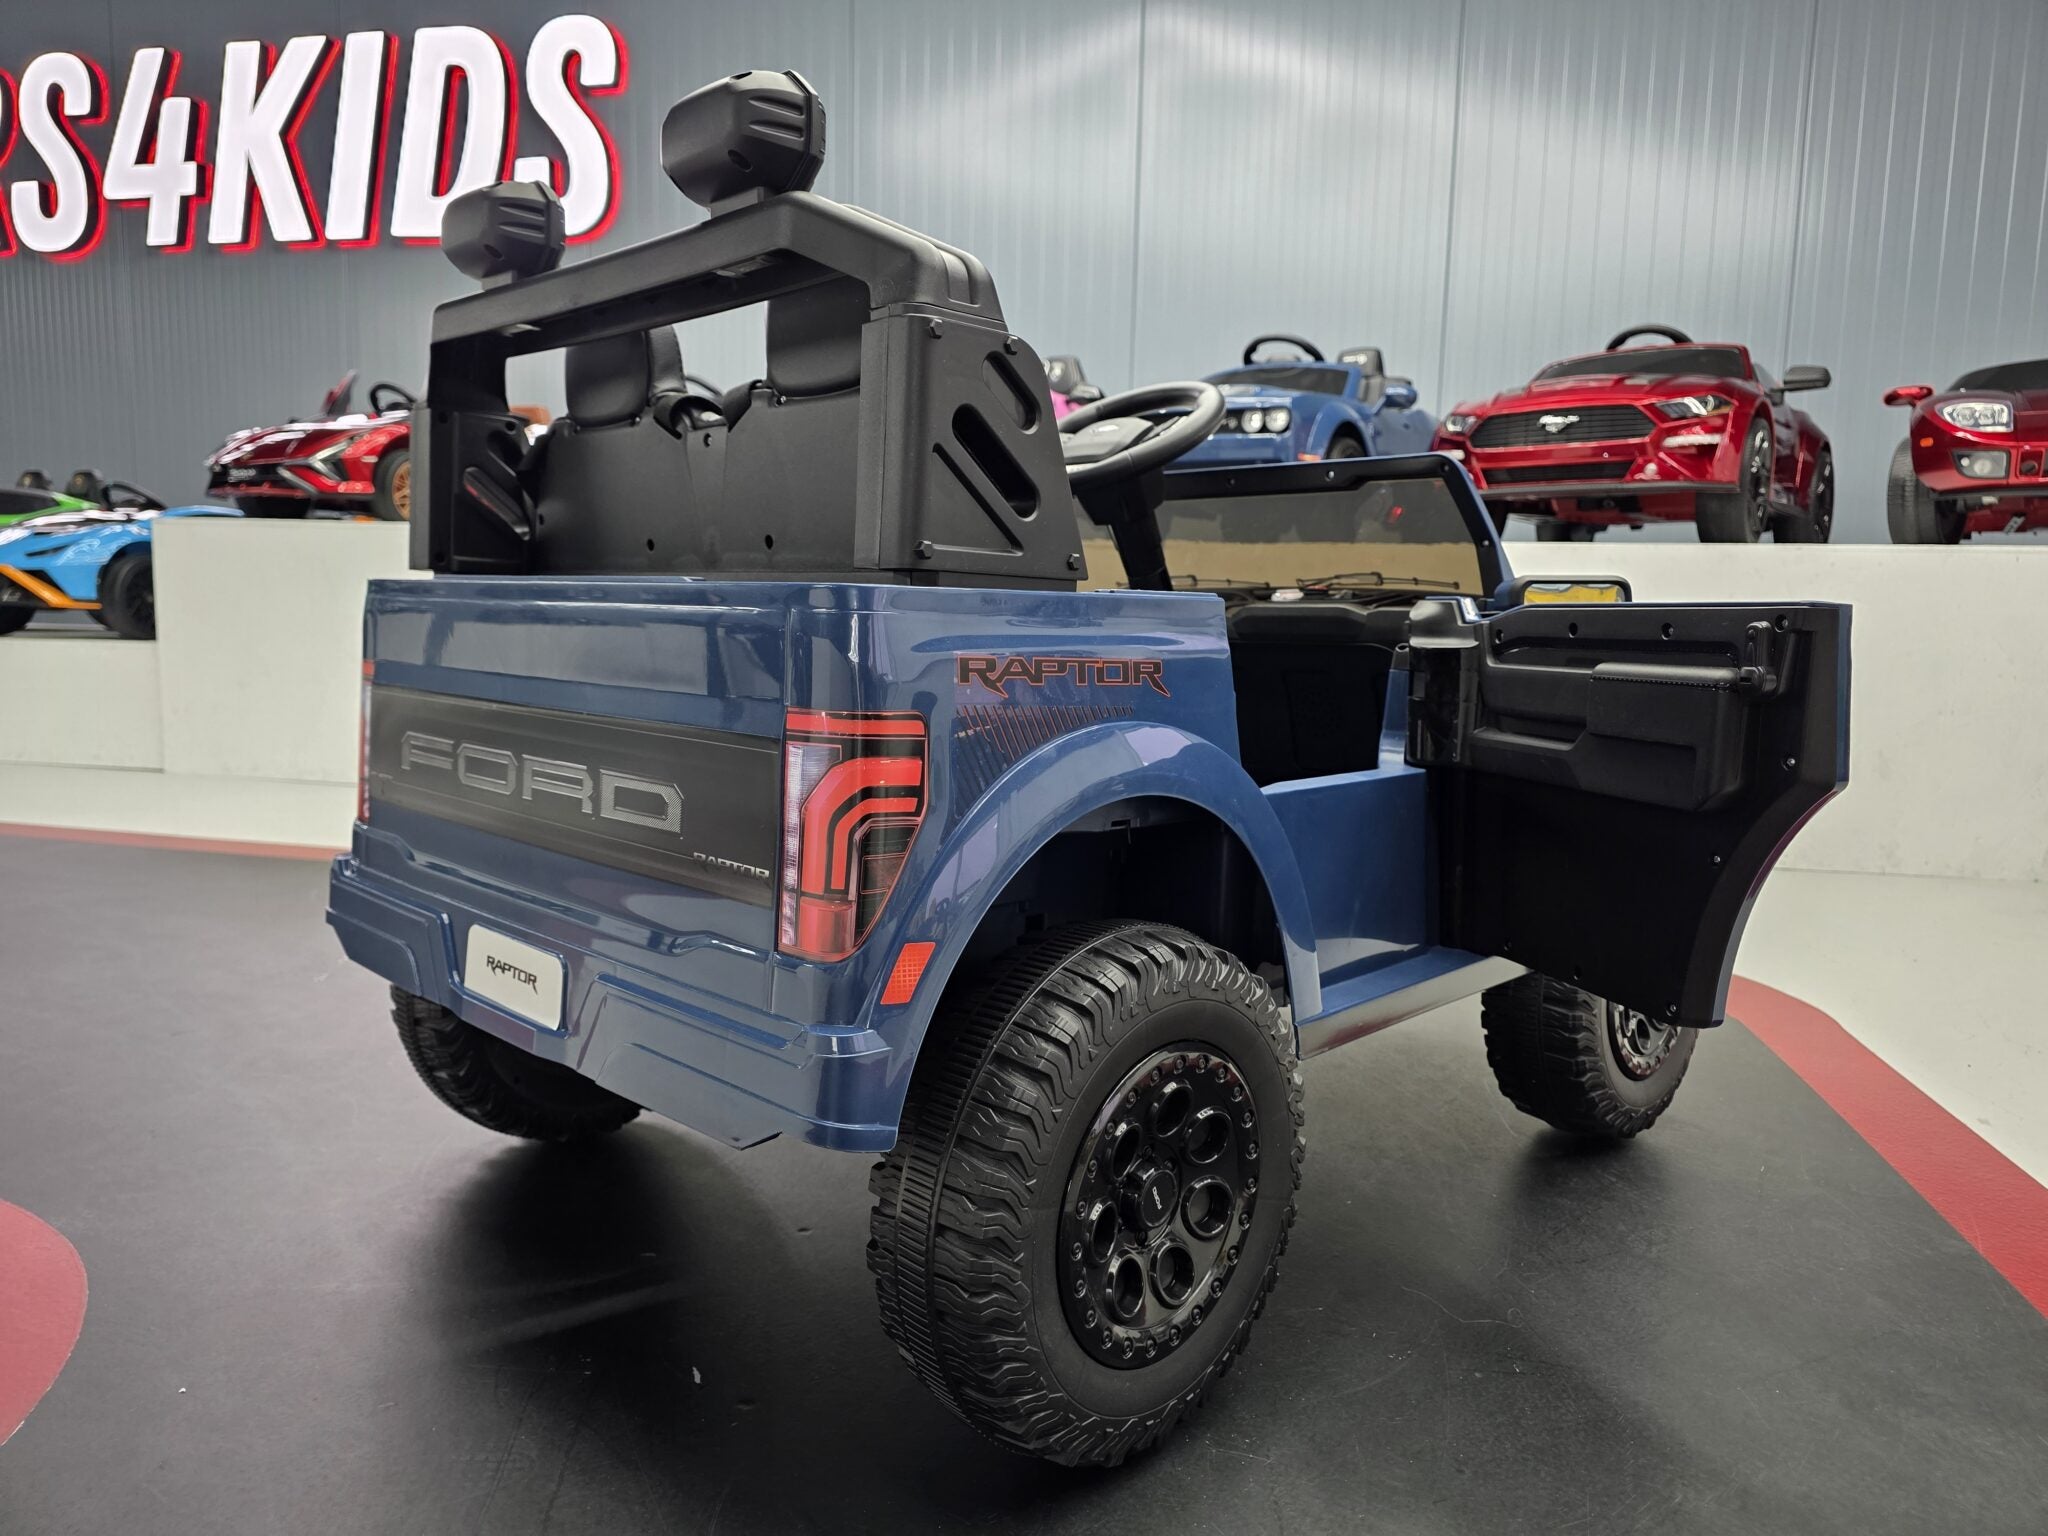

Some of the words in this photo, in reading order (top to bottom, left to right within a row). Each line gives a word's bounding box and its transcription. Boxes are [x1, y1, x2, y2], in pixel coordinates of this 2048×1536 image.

[0, 14, 622, 257] S4KIDS
[957, 656, 1171, 698] RAPTOR
[401, 731, 684, 834] FORD
[486, 954, 538, 995] RAPTOR
